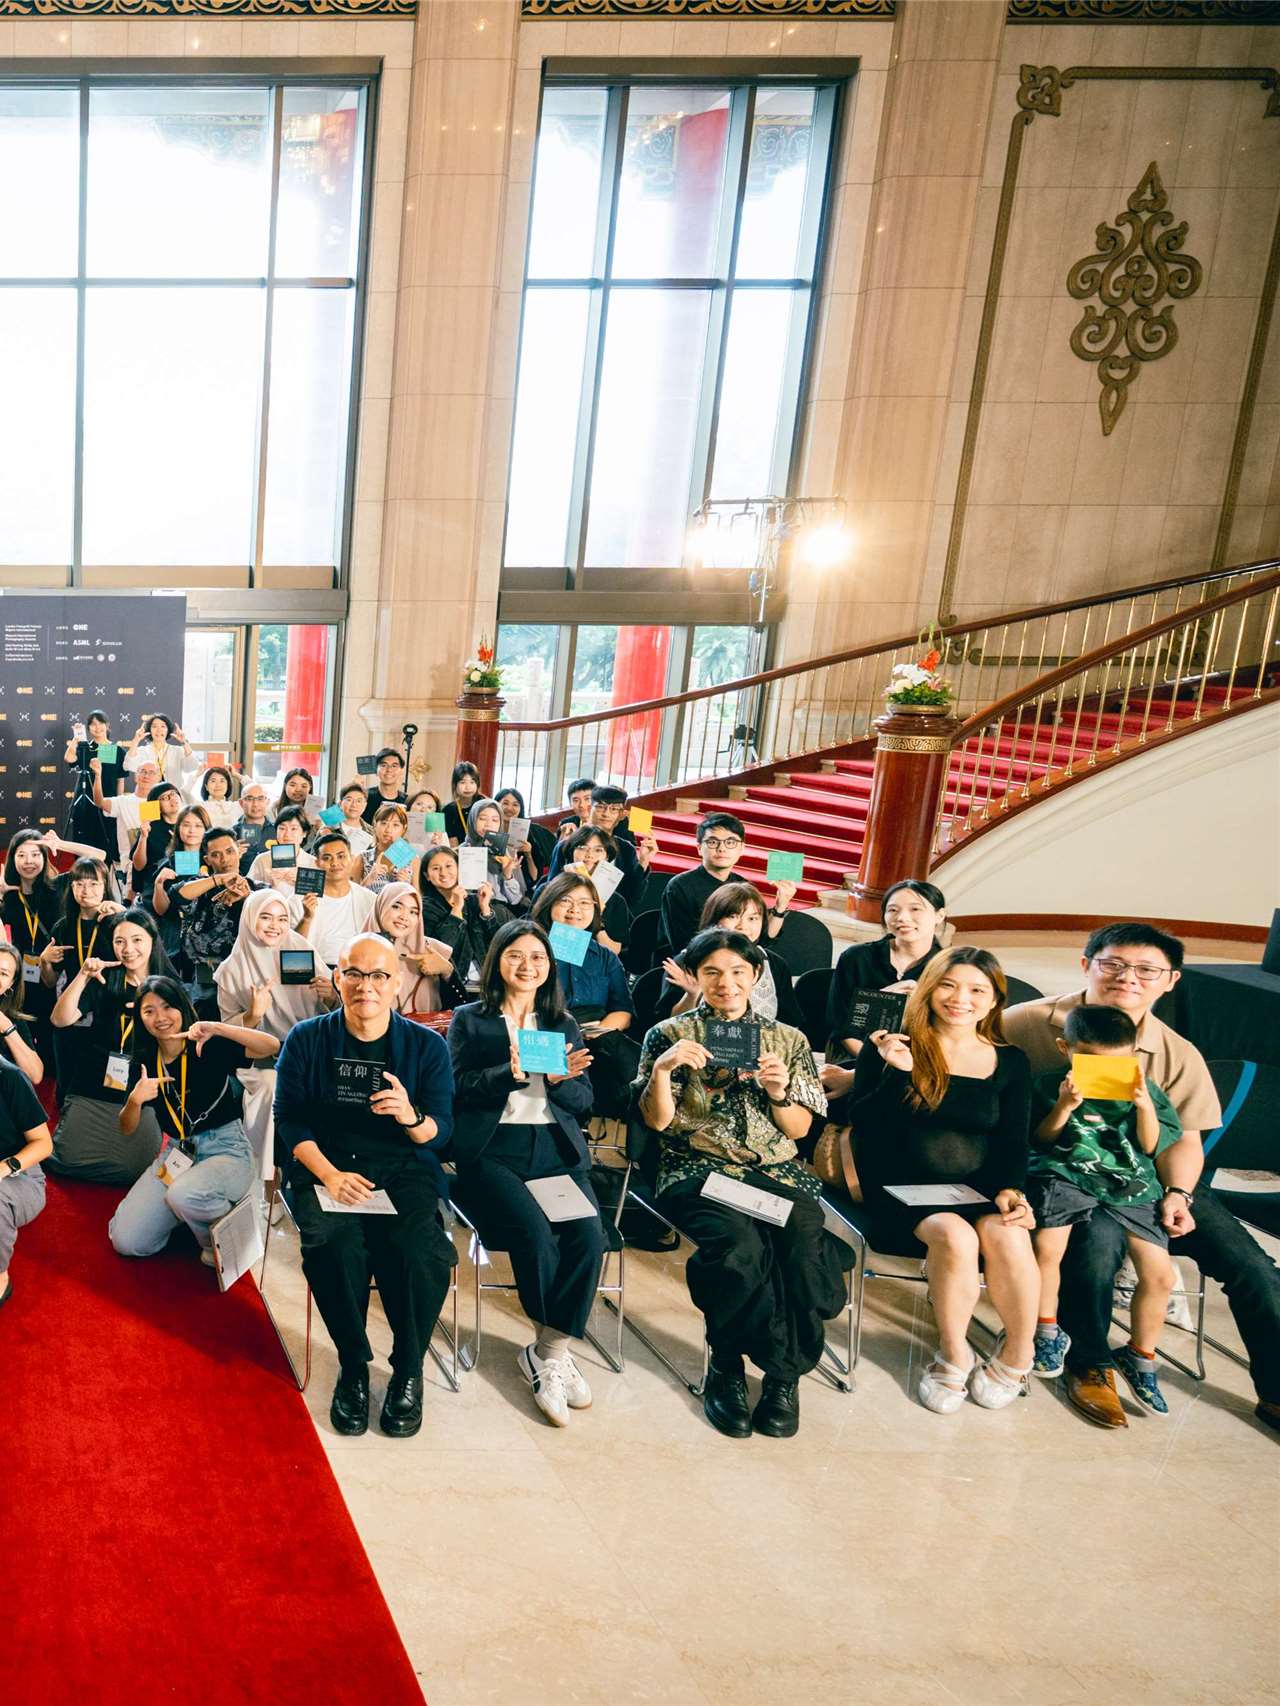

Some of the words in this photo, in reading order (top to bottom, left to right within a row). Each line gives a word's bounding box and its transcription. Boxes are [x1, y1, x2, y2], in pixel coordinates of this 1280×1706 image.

[712, 1024, 742, 1039] 奉獻
[338, 1063, 368, 1078] 信仰
[372, 1066, 382, 1091] FAITH
